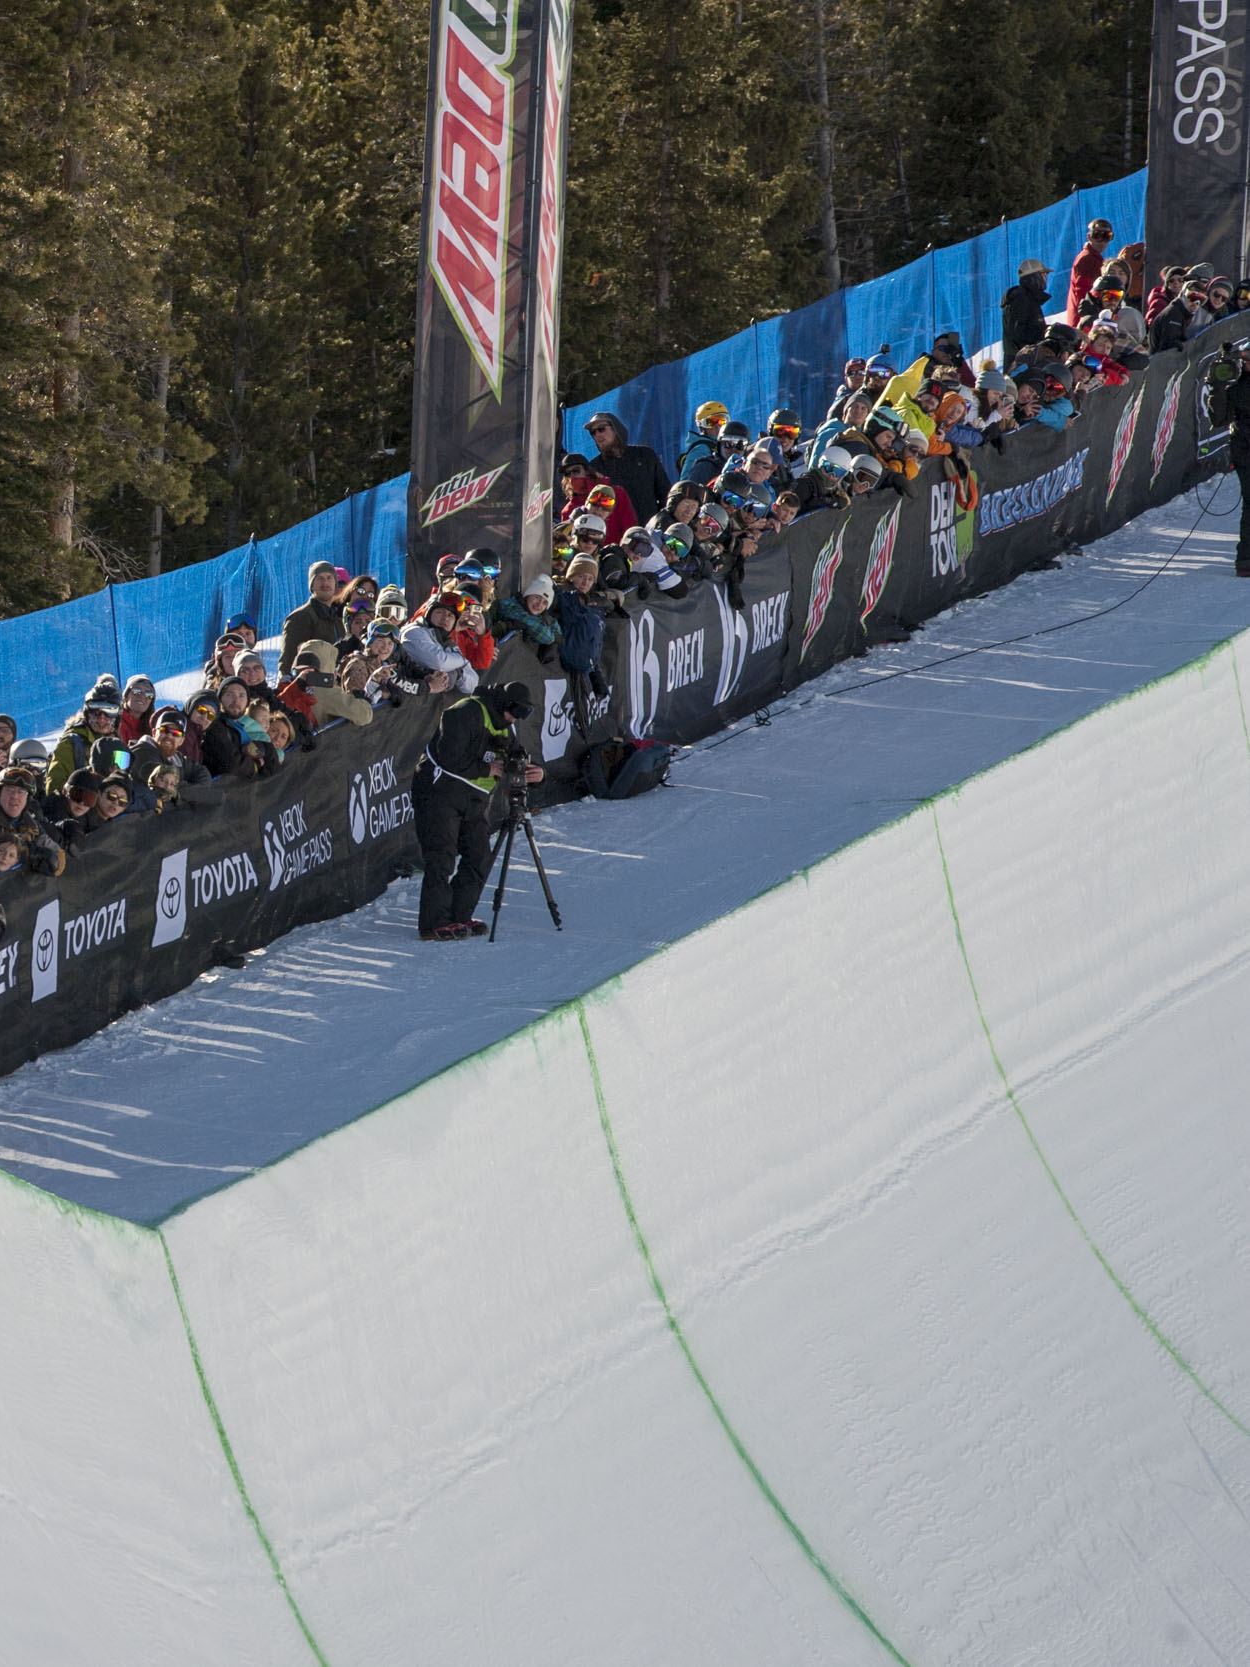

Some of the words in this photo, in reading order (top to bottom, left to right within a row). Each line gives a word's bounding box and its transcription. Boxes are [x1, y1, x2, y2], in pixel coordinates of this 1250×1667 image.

[1173, 0, 1227, 145] PASS
[751, 591, 790, 655] BRECK
[666, 628, 705, 693] BRECK
[368, 755, 397, 798] XBOX
[279, 801, 308, 845] XBOX
[369, 795, 401, 839] GAME
[191, 852, 259, 908] TOYOTA
[64, 898, 126, 960] TOYOTA
